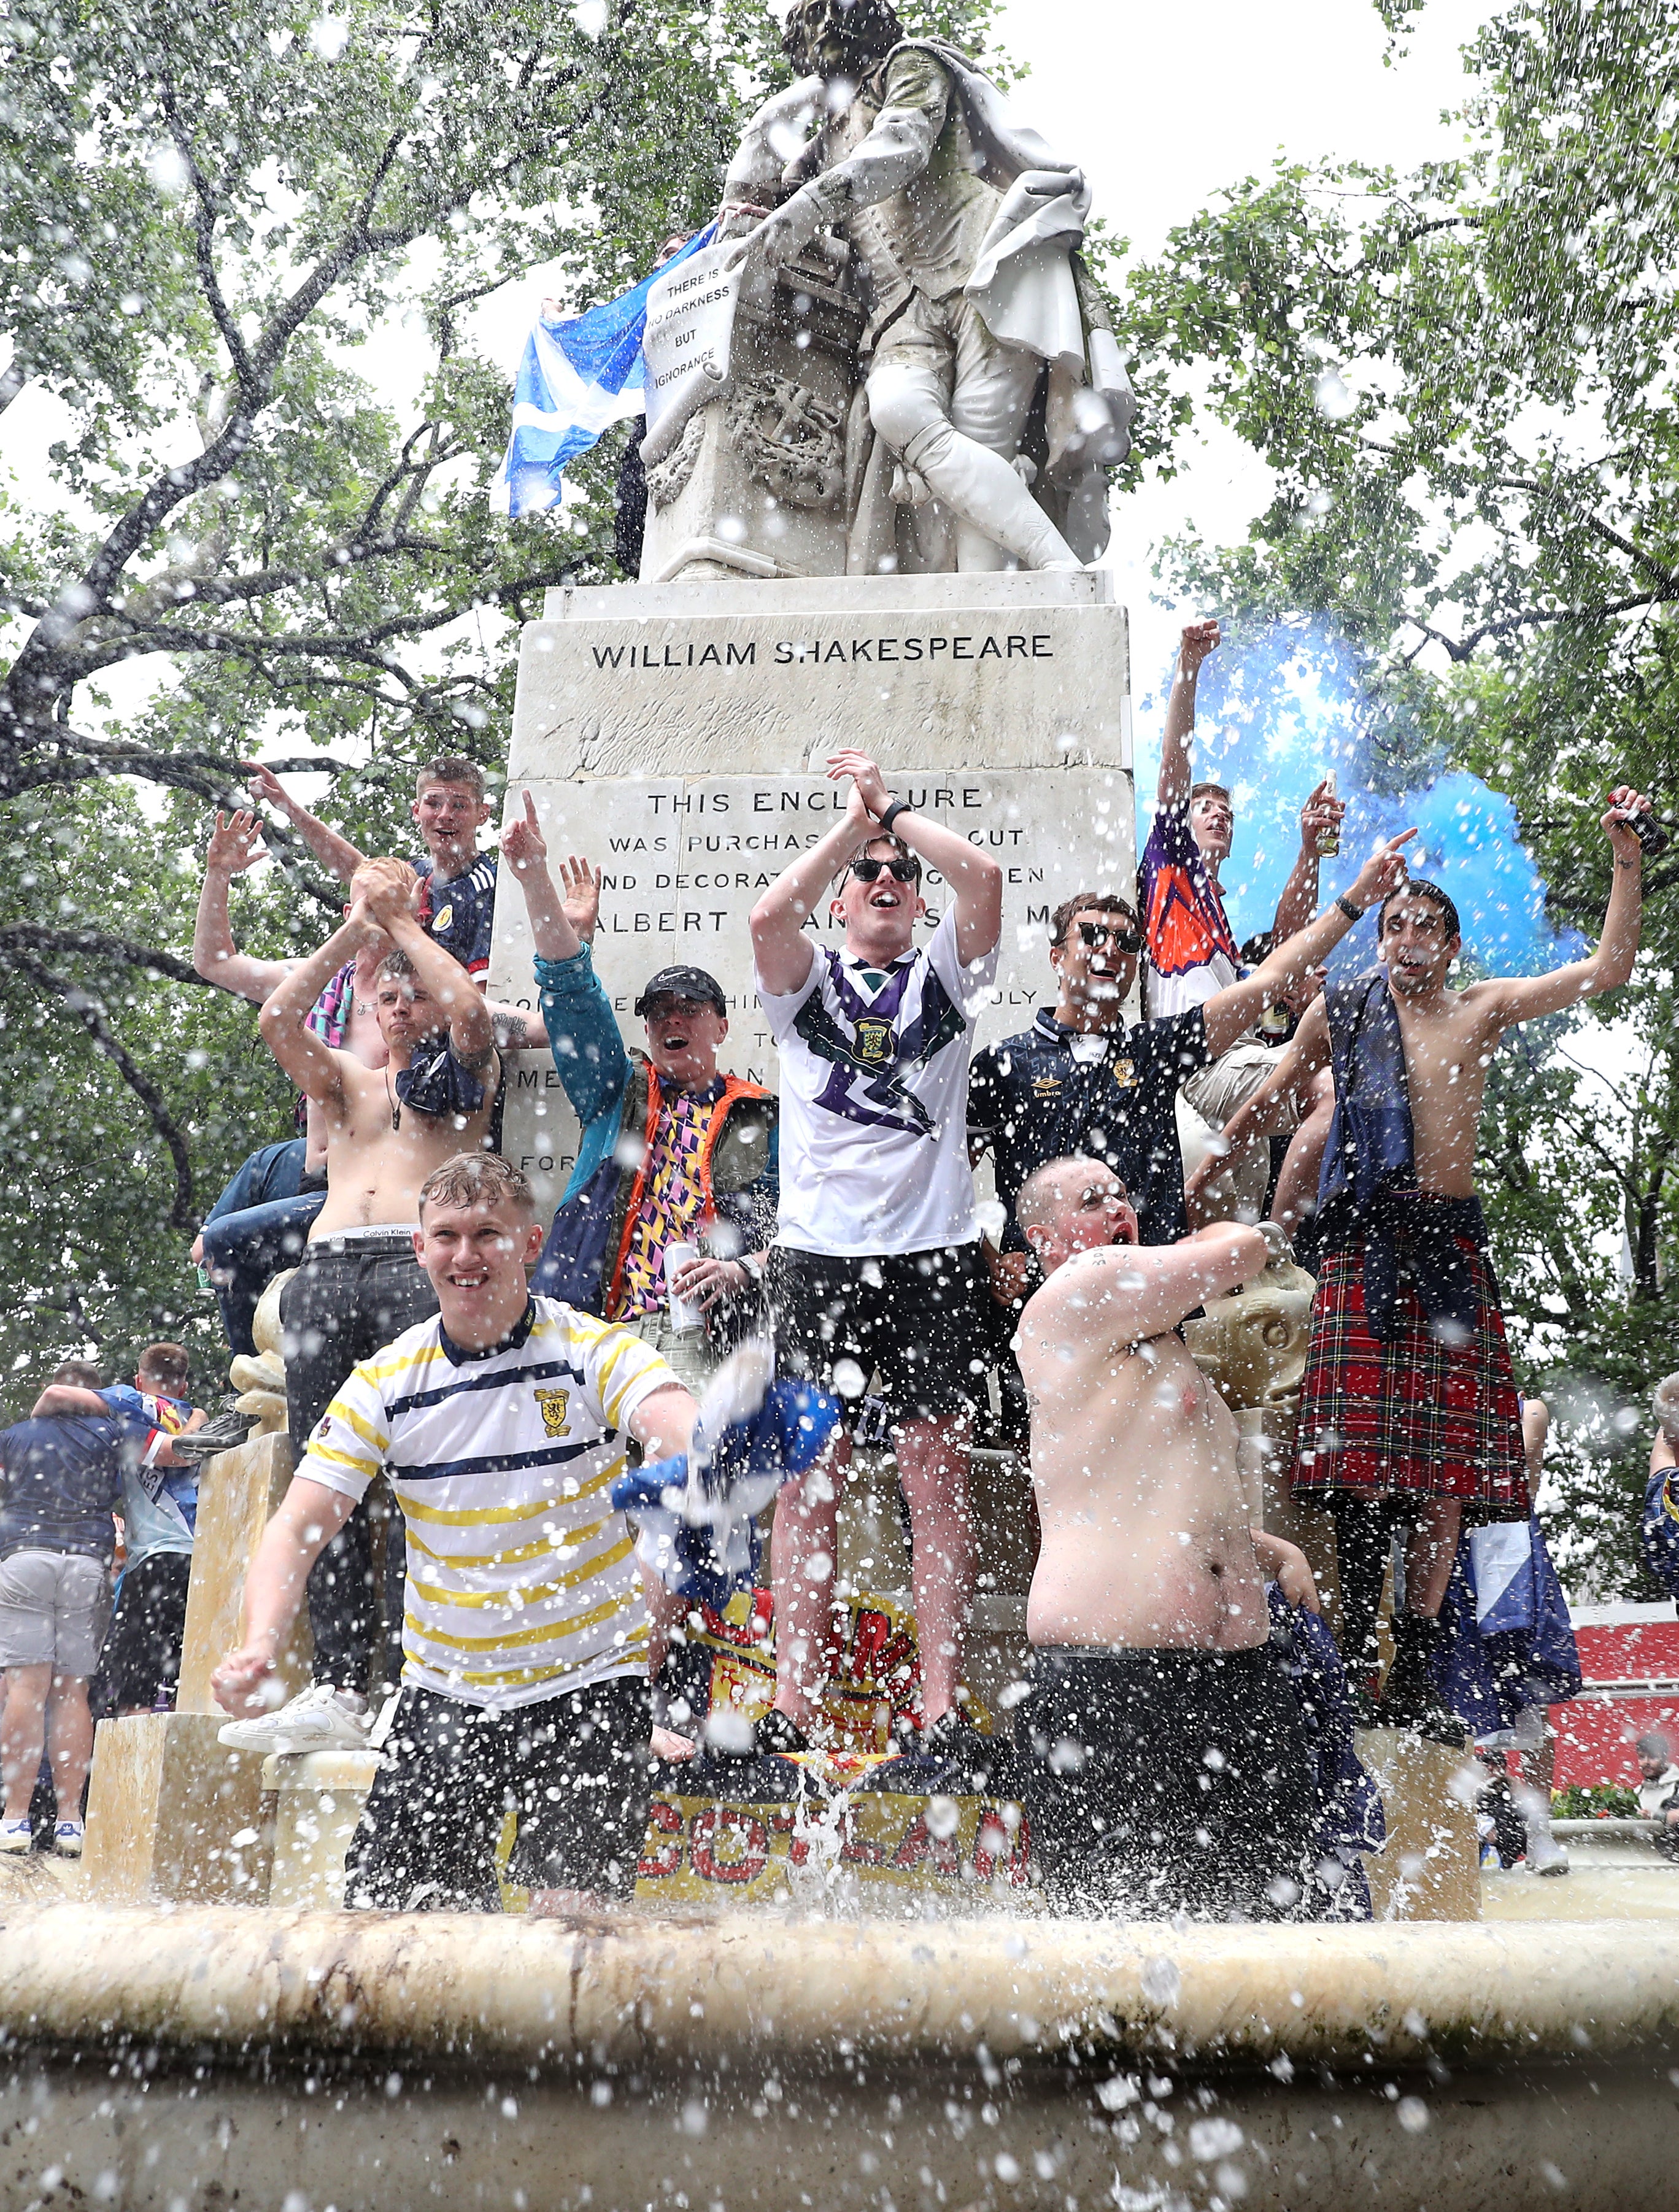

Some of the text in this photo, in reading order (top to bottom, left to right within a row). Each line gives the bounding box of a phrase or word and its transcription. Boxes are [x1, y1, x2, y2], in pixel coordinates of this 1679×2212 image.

[667, 268, 719, 298] THERE IS
[648, 286, 730, 329] NO DARKNESS
[675, 329, 697, 347] BUT
[655, 347, 714, 389] IGNORANCE
[592, 634, 1054, 669] WILLIAM SHAKESPEARE
[647, 788, 982, 814] THIS ENCLURE
[609, 836, 668, 853] WAS
[968, 830, 1023, 846] OUT
[602, 875, 636, 890] ND
